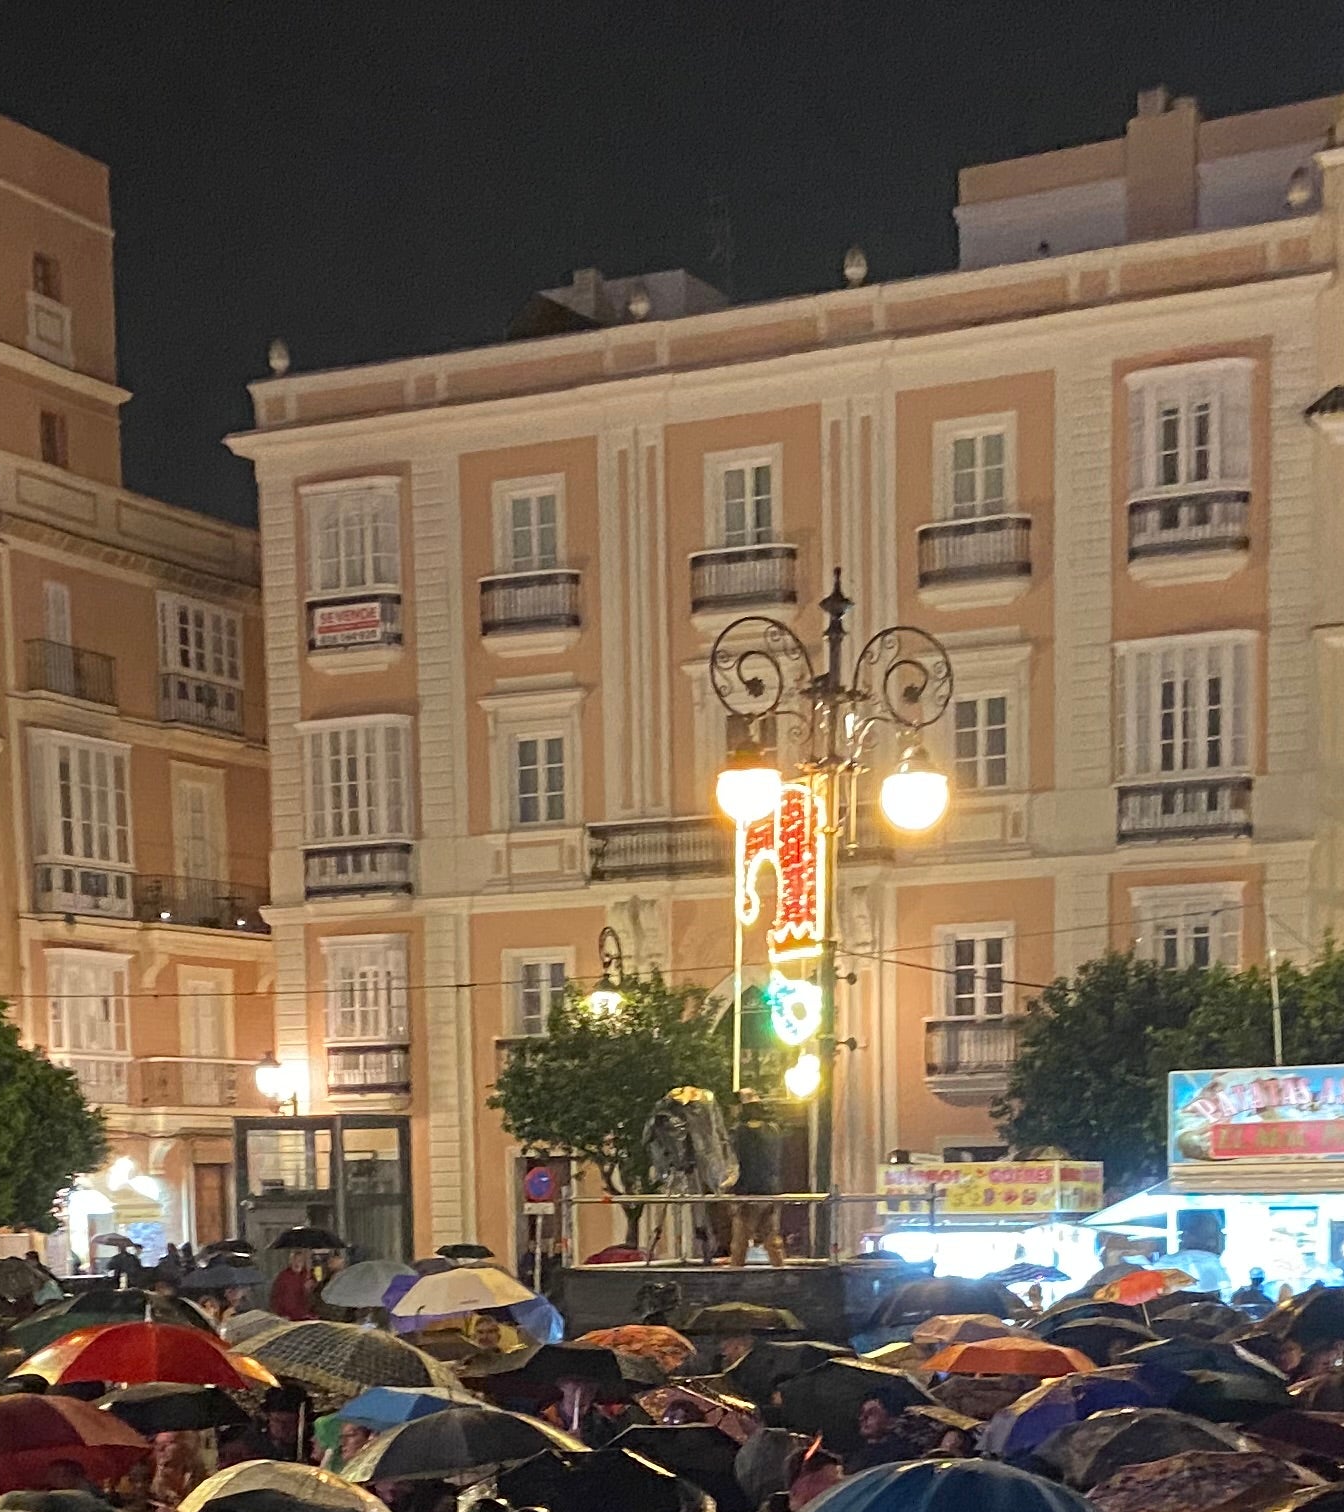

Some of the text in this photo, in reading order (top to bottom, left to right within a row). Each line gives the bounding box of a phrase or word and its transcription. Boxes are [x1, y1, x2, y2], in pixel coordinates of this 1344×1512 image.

[321, 607, 377, 624] SE VENDE
[1194, 1077, 1313, 1123] PATATAS
